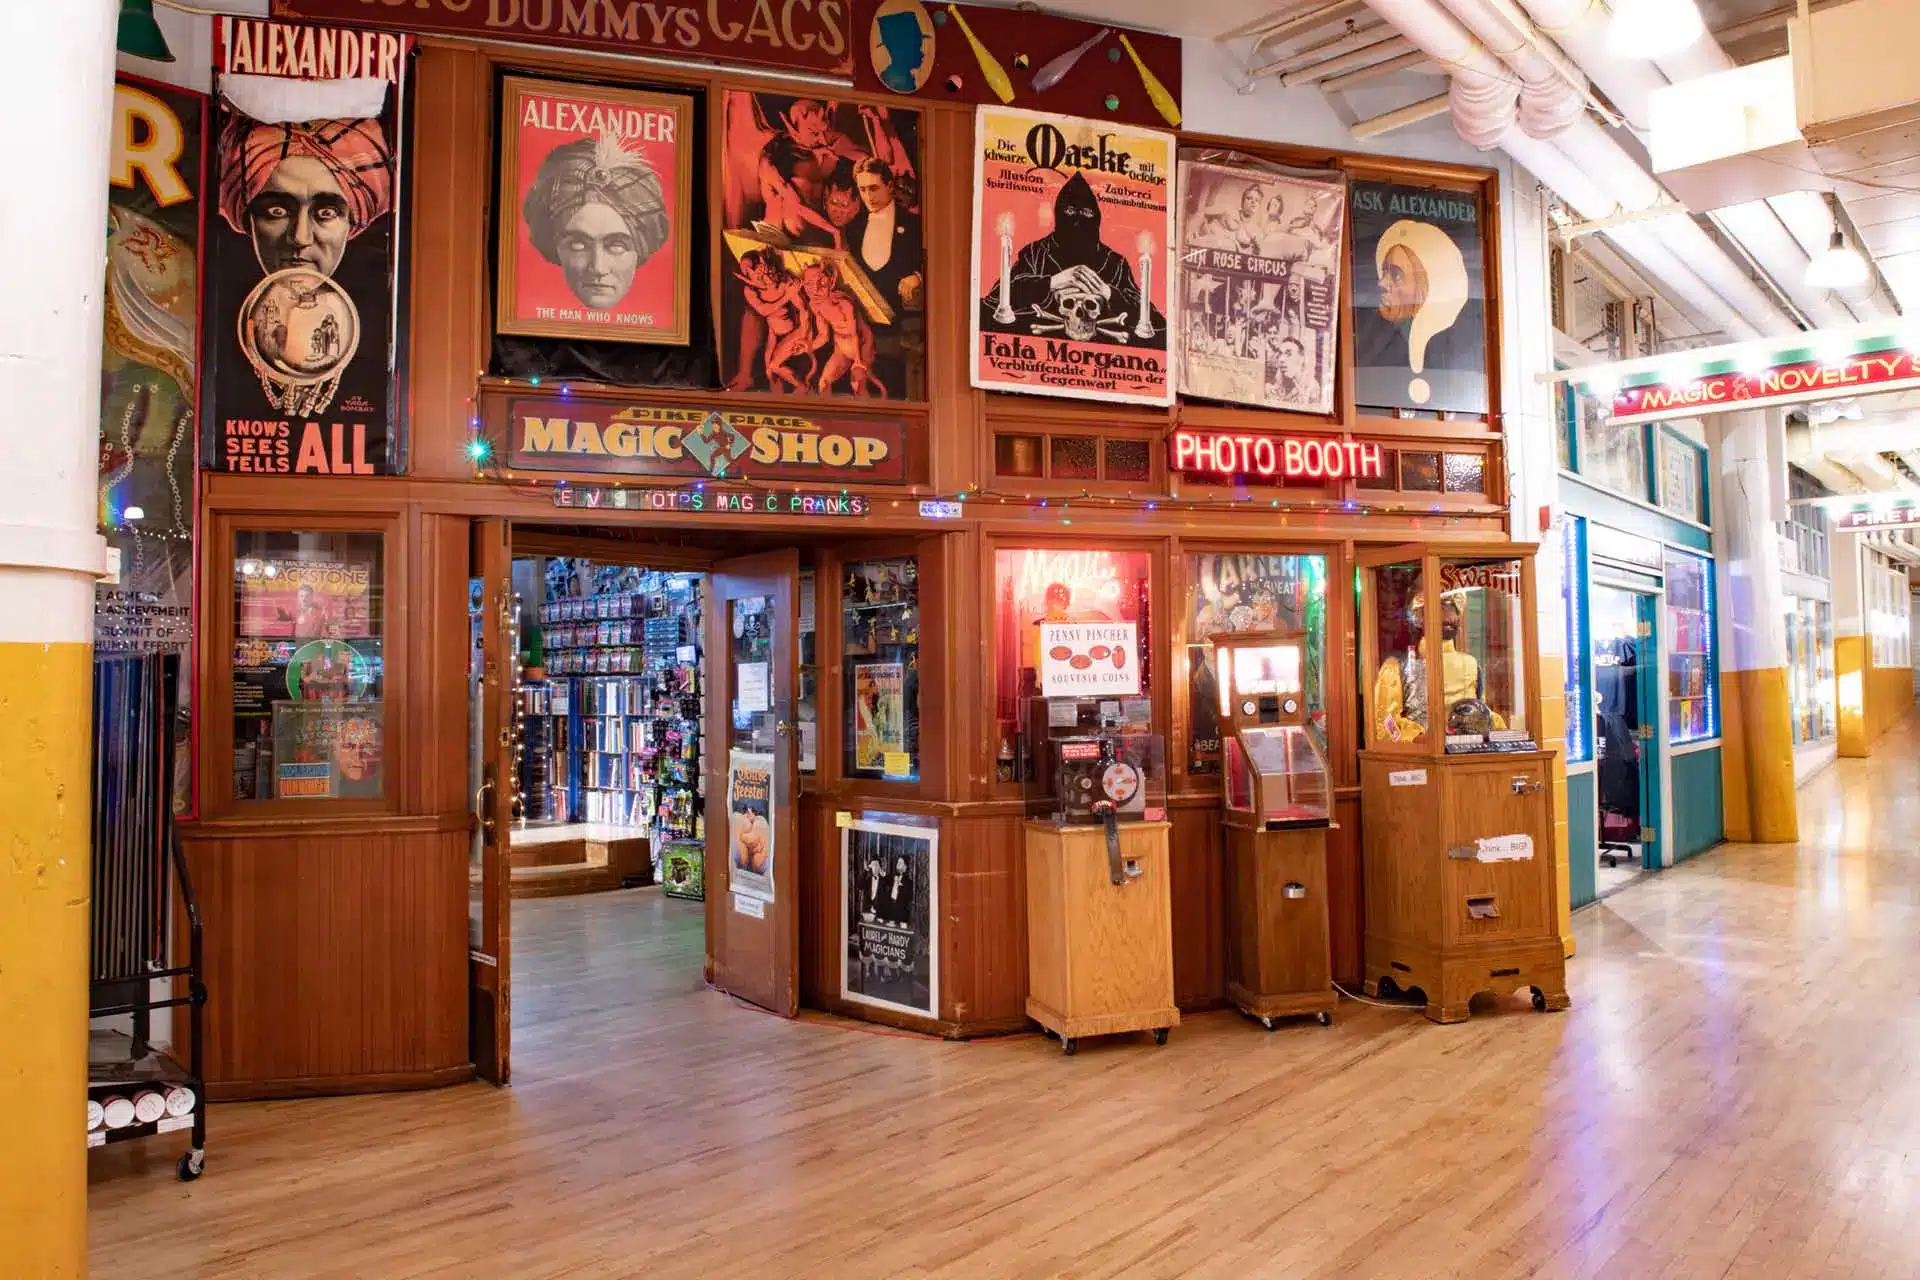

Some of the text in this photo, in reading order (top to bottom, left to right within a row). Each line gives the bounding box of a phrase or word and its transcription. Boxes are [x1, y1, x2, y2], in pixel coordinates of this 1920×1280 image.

[485, 0, 700, 47] DUMMYS
[232, 21, 397, 83] ALEXANDER
[523, 99, 675, 143] ALEXANDER
[997, 138, 1017, 153] Die
[1138, 161, 1156, 174] mit
[1104, 183, 1152, 200] Zauberei
[1353, 189, 1477, 223] ASK ALEXANDER
[1212, 251, 1243, 270] ROSE
[1247, 257, 1288, 277] CIRCUS
[535, 306, 654, 325] THE MAN WHO KNOWS
[983, 334, 1036, 360] Fata
[1039, 373, 1117, 391] Gegenwart
[1145, 373, 1166, 385] der
[1640, 380, 1726, 410] MAGIC
[1758, 356, 1904, 394] NOVELTY
[630, 408, 807, 428] PIKE PLACE
[225, 419, 290, 437] KNOWS
[226, 437, 290, 456] SEES
[295, 422, 375, 475] ALL
[520, 416, 889, 467] MAGIC SHOP
[225, 455, 290, 473] TELLS
[1175, 432, 1383, 478] PHOTO BOOTH
[788, 496, 863, 515] PRANKS
[1440, 561, 1521, 595] Swami
[106, 606, 191, 617] ACHIEVEMENT
[124, 617, 153, 626] THE
[102, 626, 175, 638] SUMMIT OF
[1049, 628, 1130, 642] PENNY PINCHER
[143, 641, 189, 652] EFFORT
[1051, 672, 1131, 684] SOUVENIR COINS
[861, 927, 881, 944] LAUREL
[888, 931, 911, 948] HARDY
[864, 941, 906, 960] MAGICIANS
